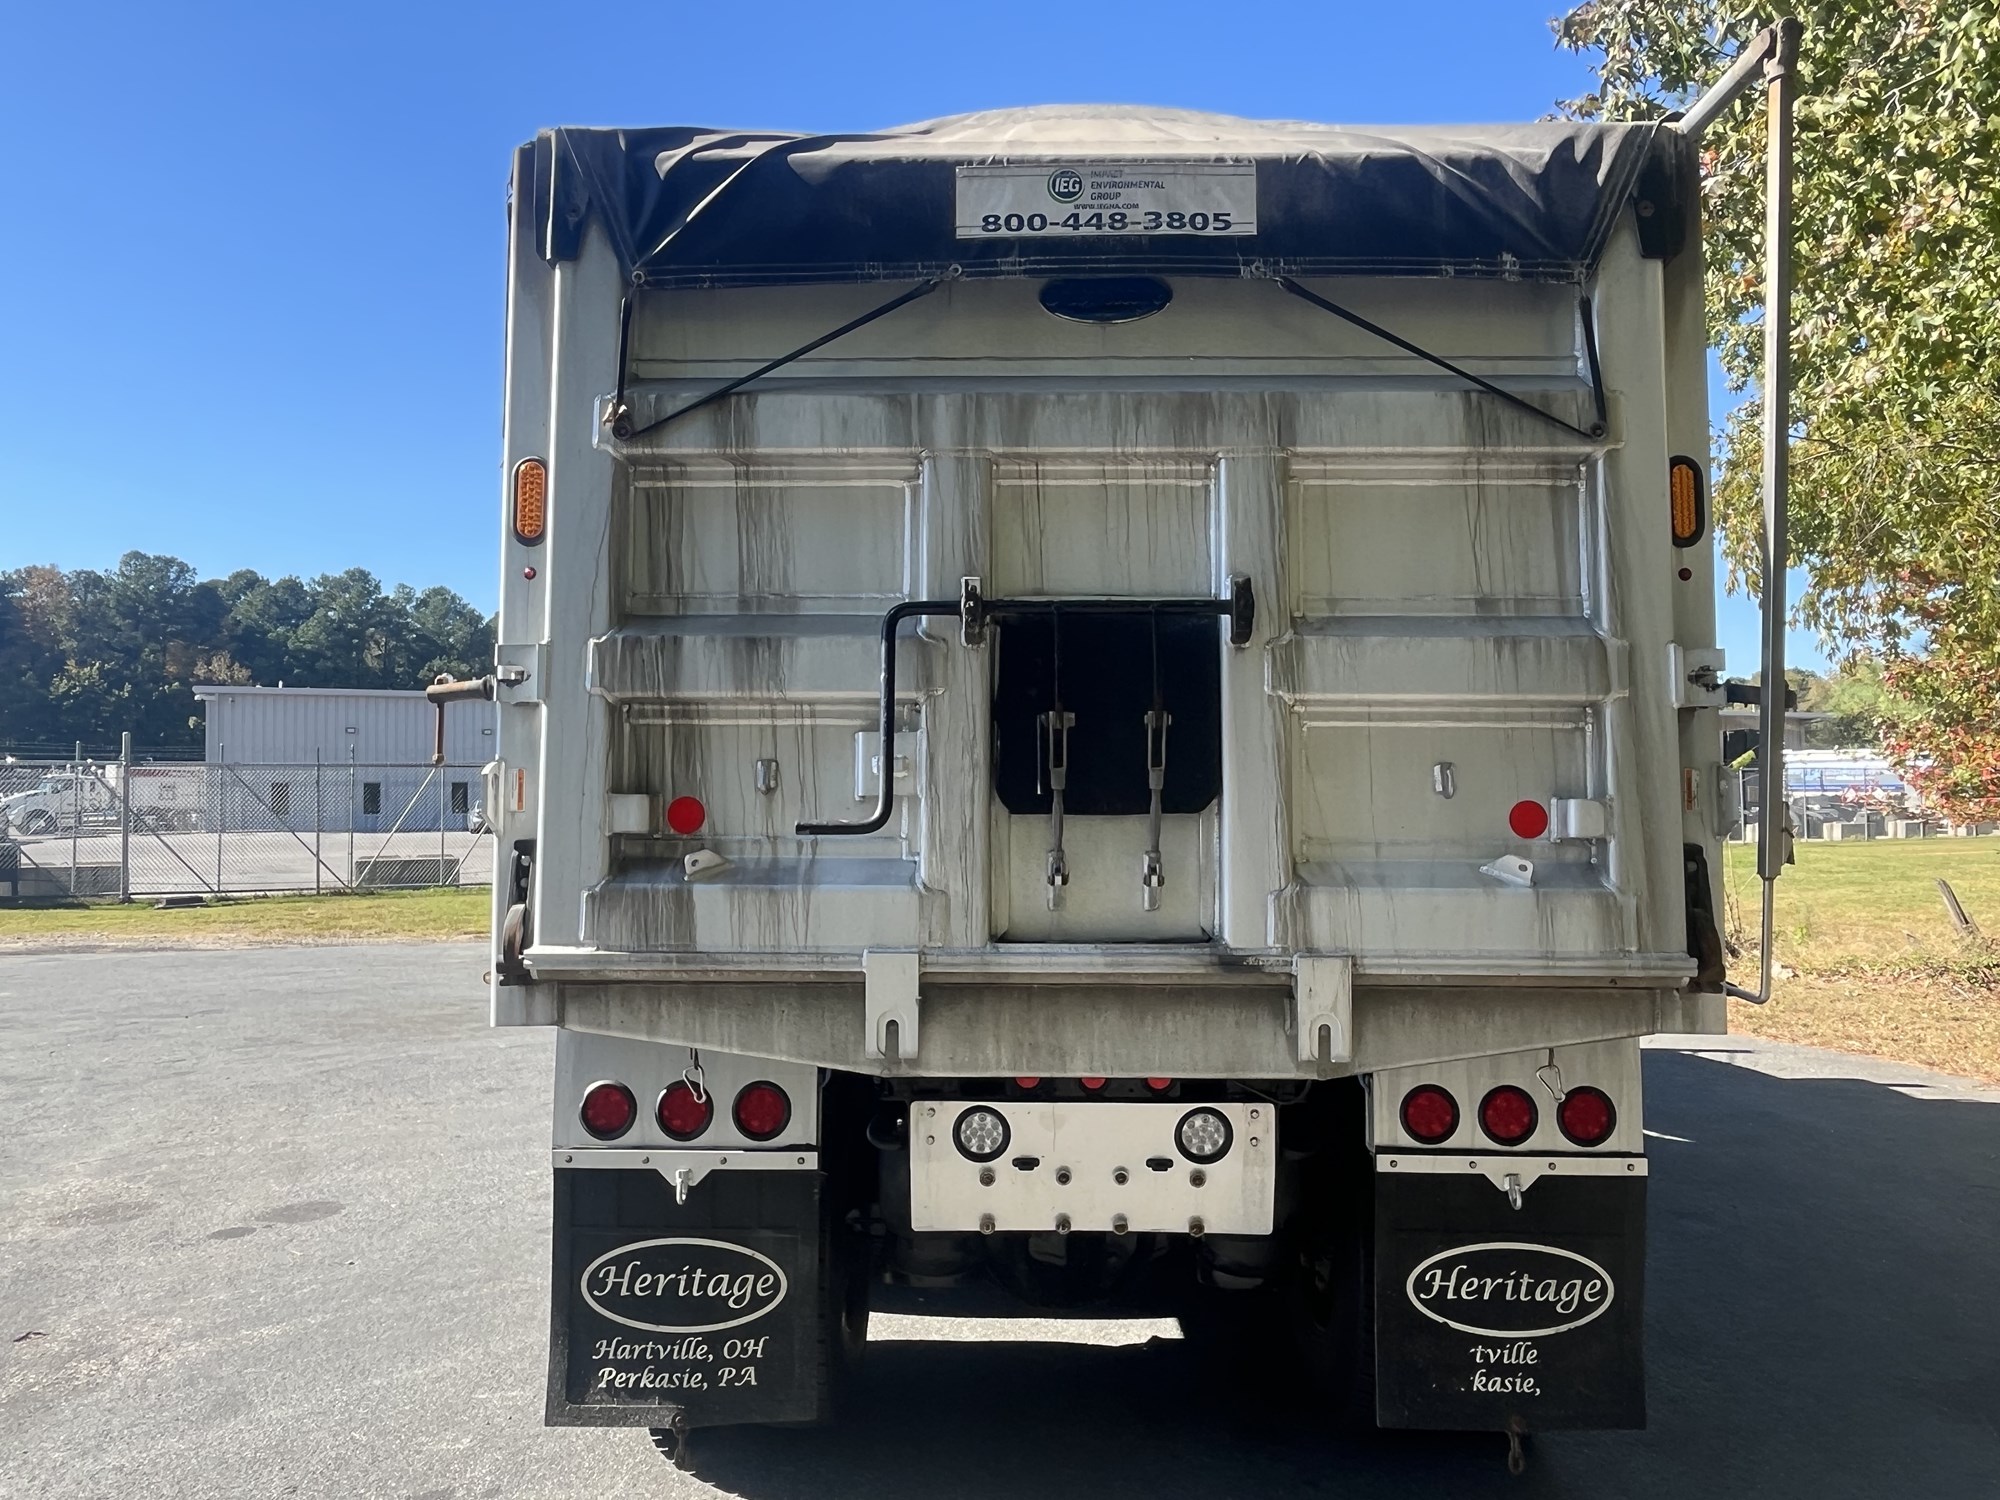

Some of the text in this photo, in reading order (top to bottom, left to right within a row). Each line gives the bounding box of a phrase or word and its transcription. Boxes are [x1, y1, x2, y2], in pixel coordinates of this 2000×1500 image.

[1055, 177, 1080, 192] IEG
[1090, 180, 1166, 190] ENVIRONMENTAL
[1090, 191, 1121, 200] GROUP
[981, 211, 1232, 232] 800-448-3805
[593, 1261, 774, 1309] Heritage
[1420, 1265, 1602, 1314] Heritage
[592, 1336, 770, 1363] Hartville, OH
[1469, 1341, 1538, 1364] tville
[595, 1366, 758, 1392] Perkasie, PA
[1470, 1368, 1541, 1397] kasie,
